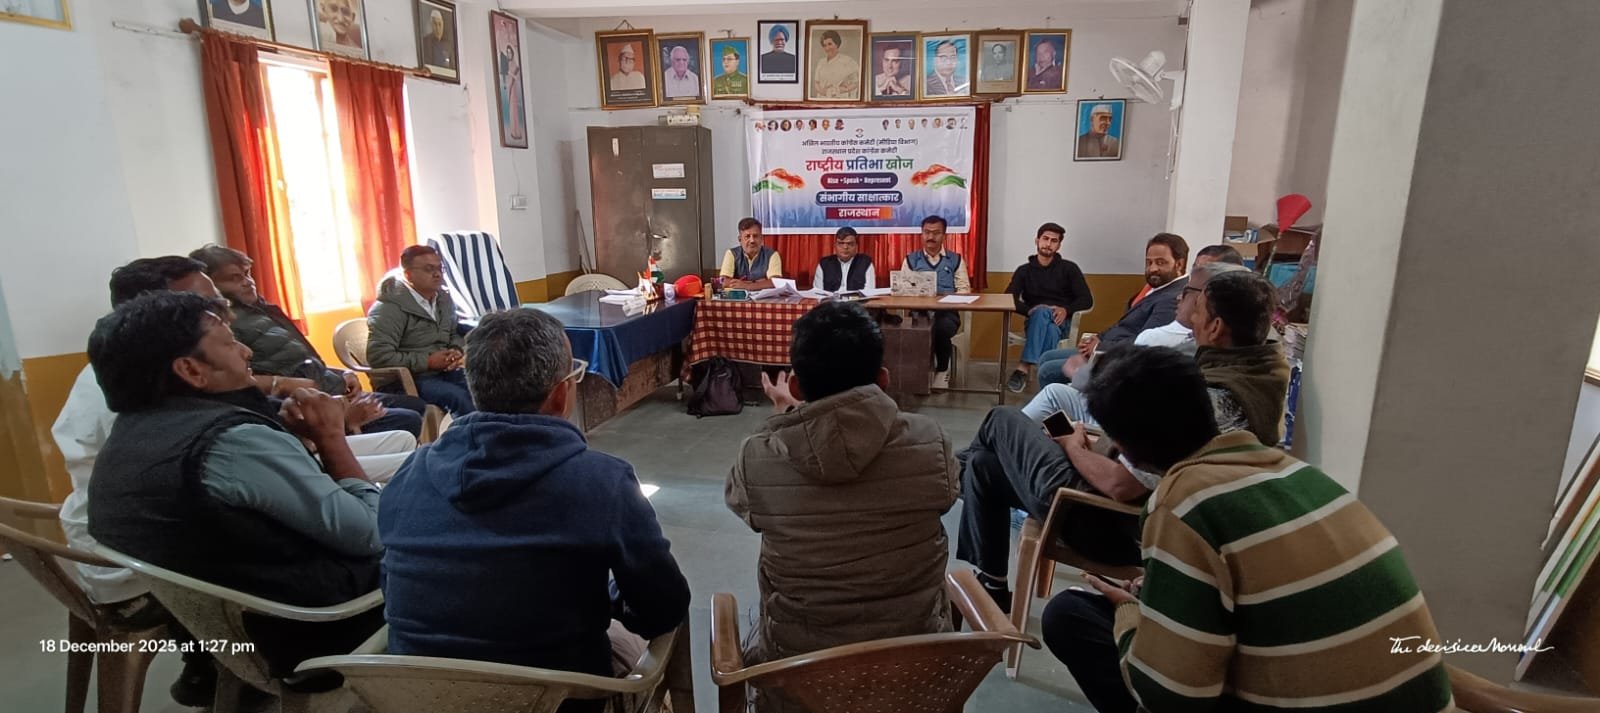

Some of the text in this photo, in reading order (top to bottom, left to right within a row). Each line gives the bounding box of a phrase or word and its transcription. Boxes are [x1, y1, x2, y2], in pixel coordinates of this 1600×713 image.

[806, 155, 914, 171] राष्ट्रीय प्रतिभा खोज
[819, 192, 899, 203] संभागीय साक्षात्कार
[838, 208, 880, 217] राजस्थान
